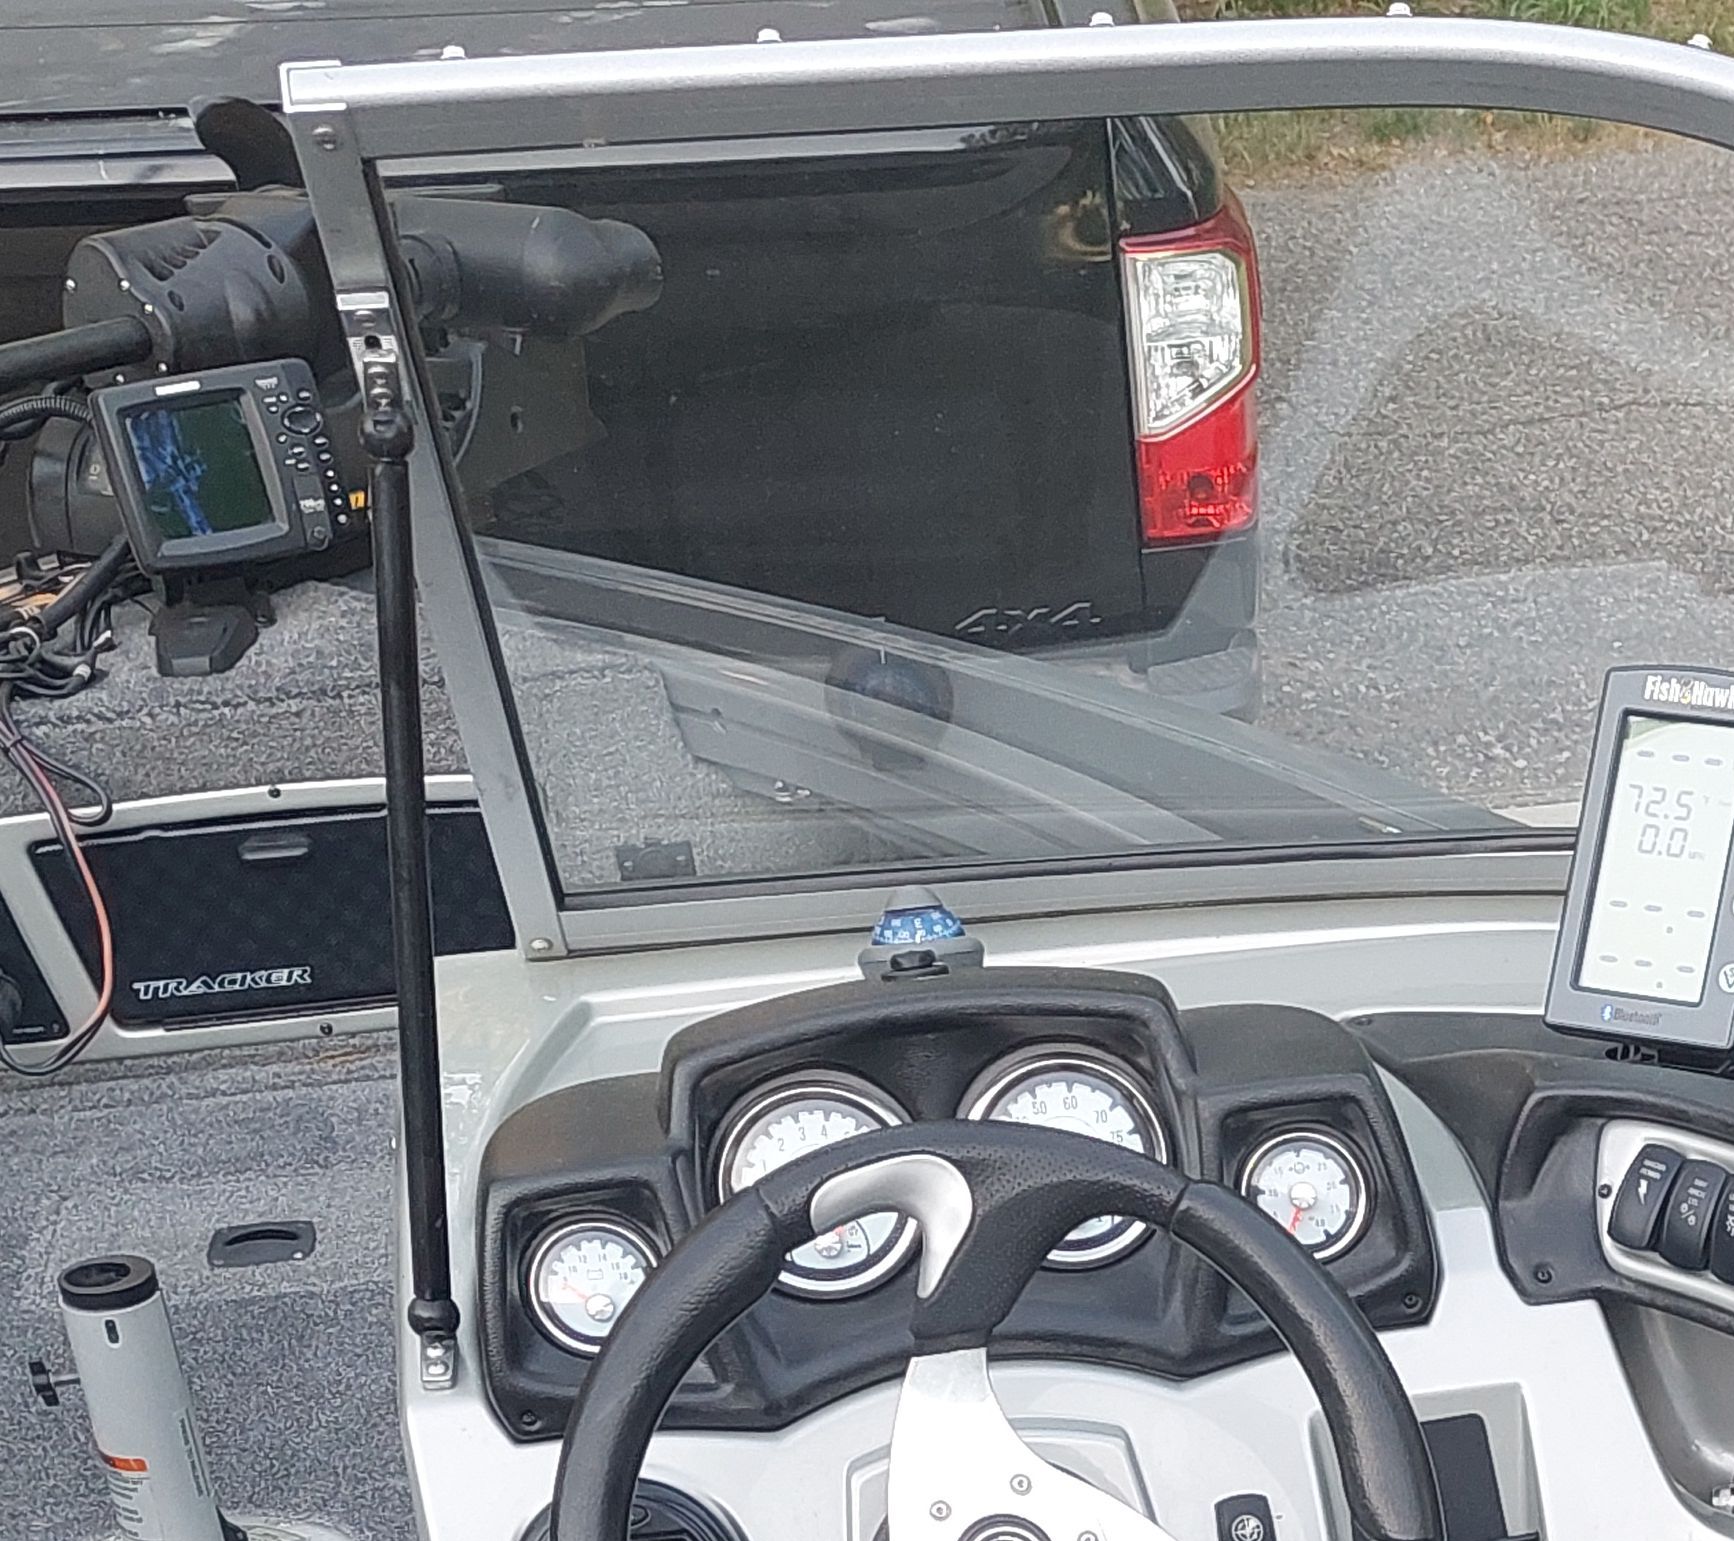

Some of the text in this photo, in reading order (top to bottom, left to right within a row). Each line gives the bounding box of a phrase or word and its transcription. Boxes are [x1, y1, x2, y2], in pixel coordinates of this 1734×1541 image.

[1644, 675, 1681, 703] Fish
[1629, 783, 1694, 821] 72.5
[1637, 823, 1688, 858] 0.0
[132, 966, 312, 1000] TRACKER
[1031, 1101, 1047, 1116] 50
[1063, 1096, 1078, 1111] 60
[1093, 1110, 1108, 1124] 70
